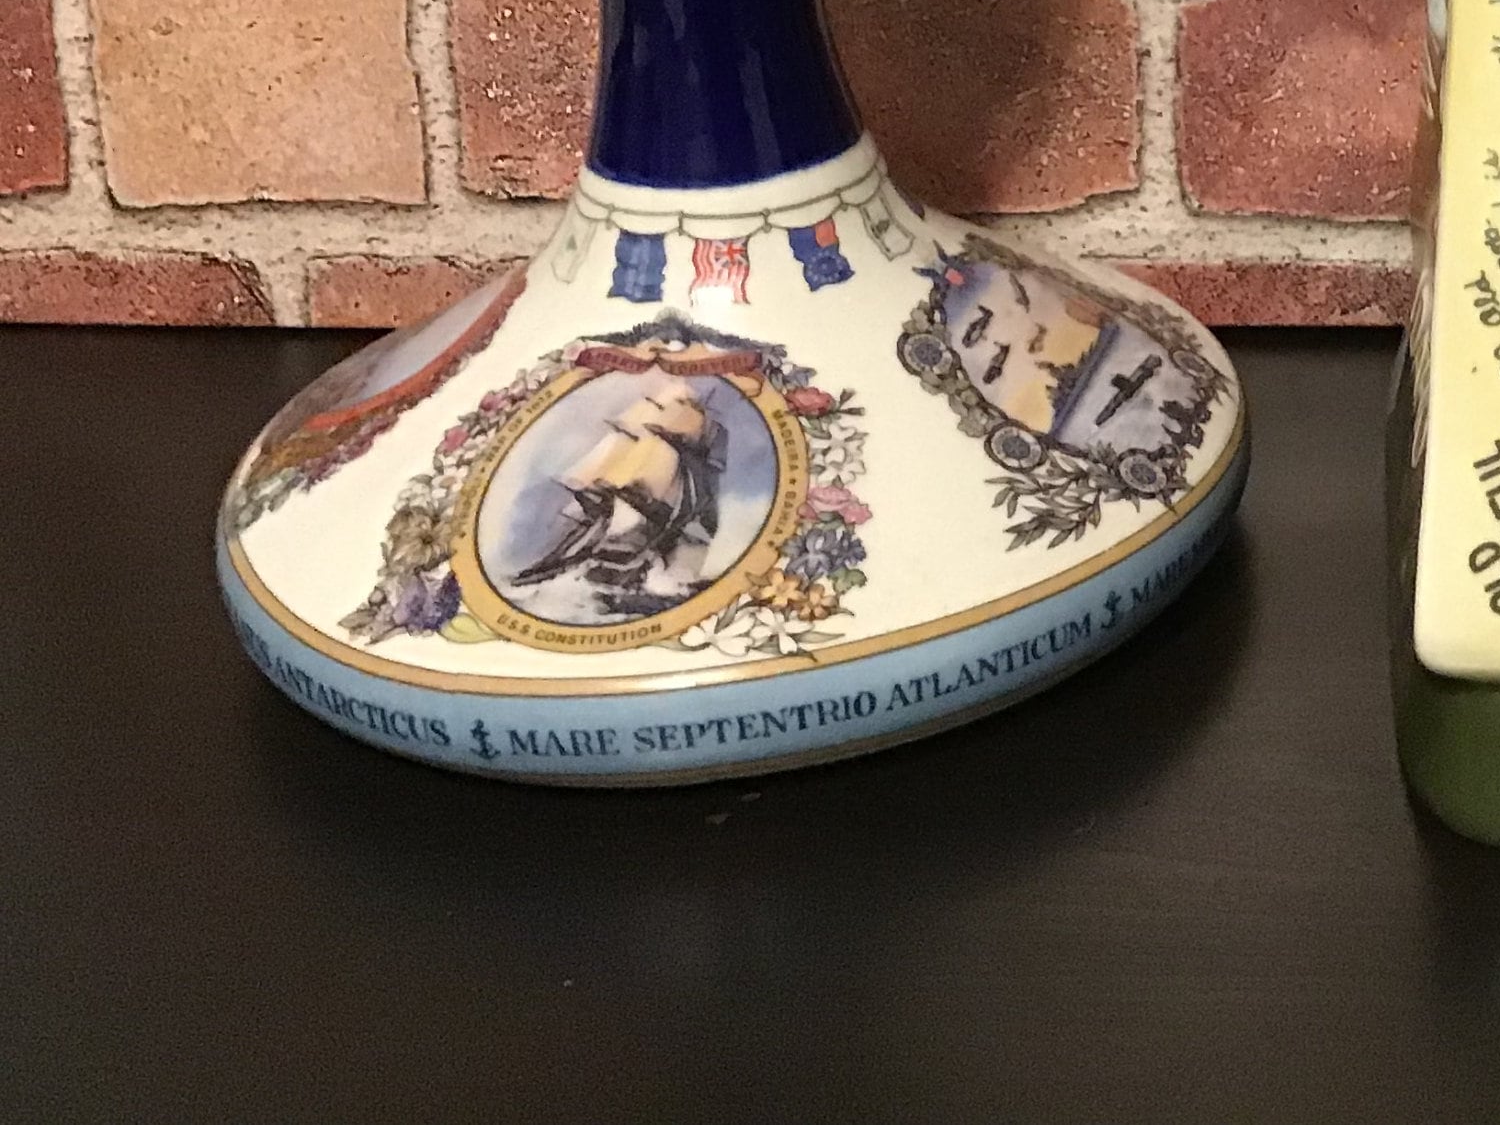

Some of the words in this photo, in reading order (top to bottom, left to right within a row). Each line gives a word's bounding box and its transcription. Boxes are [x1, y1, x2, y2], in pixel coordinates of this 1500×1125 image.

[534, 623, 662, 646] CONSTITUTION
[275, 656, 450, 747] ANTARCTICUS
[509, 727, 621, 757] MARE
[632, 690, 877, 755] SEPTENTRIO
[885, 612, 1092, 713] ATLANTICUM
